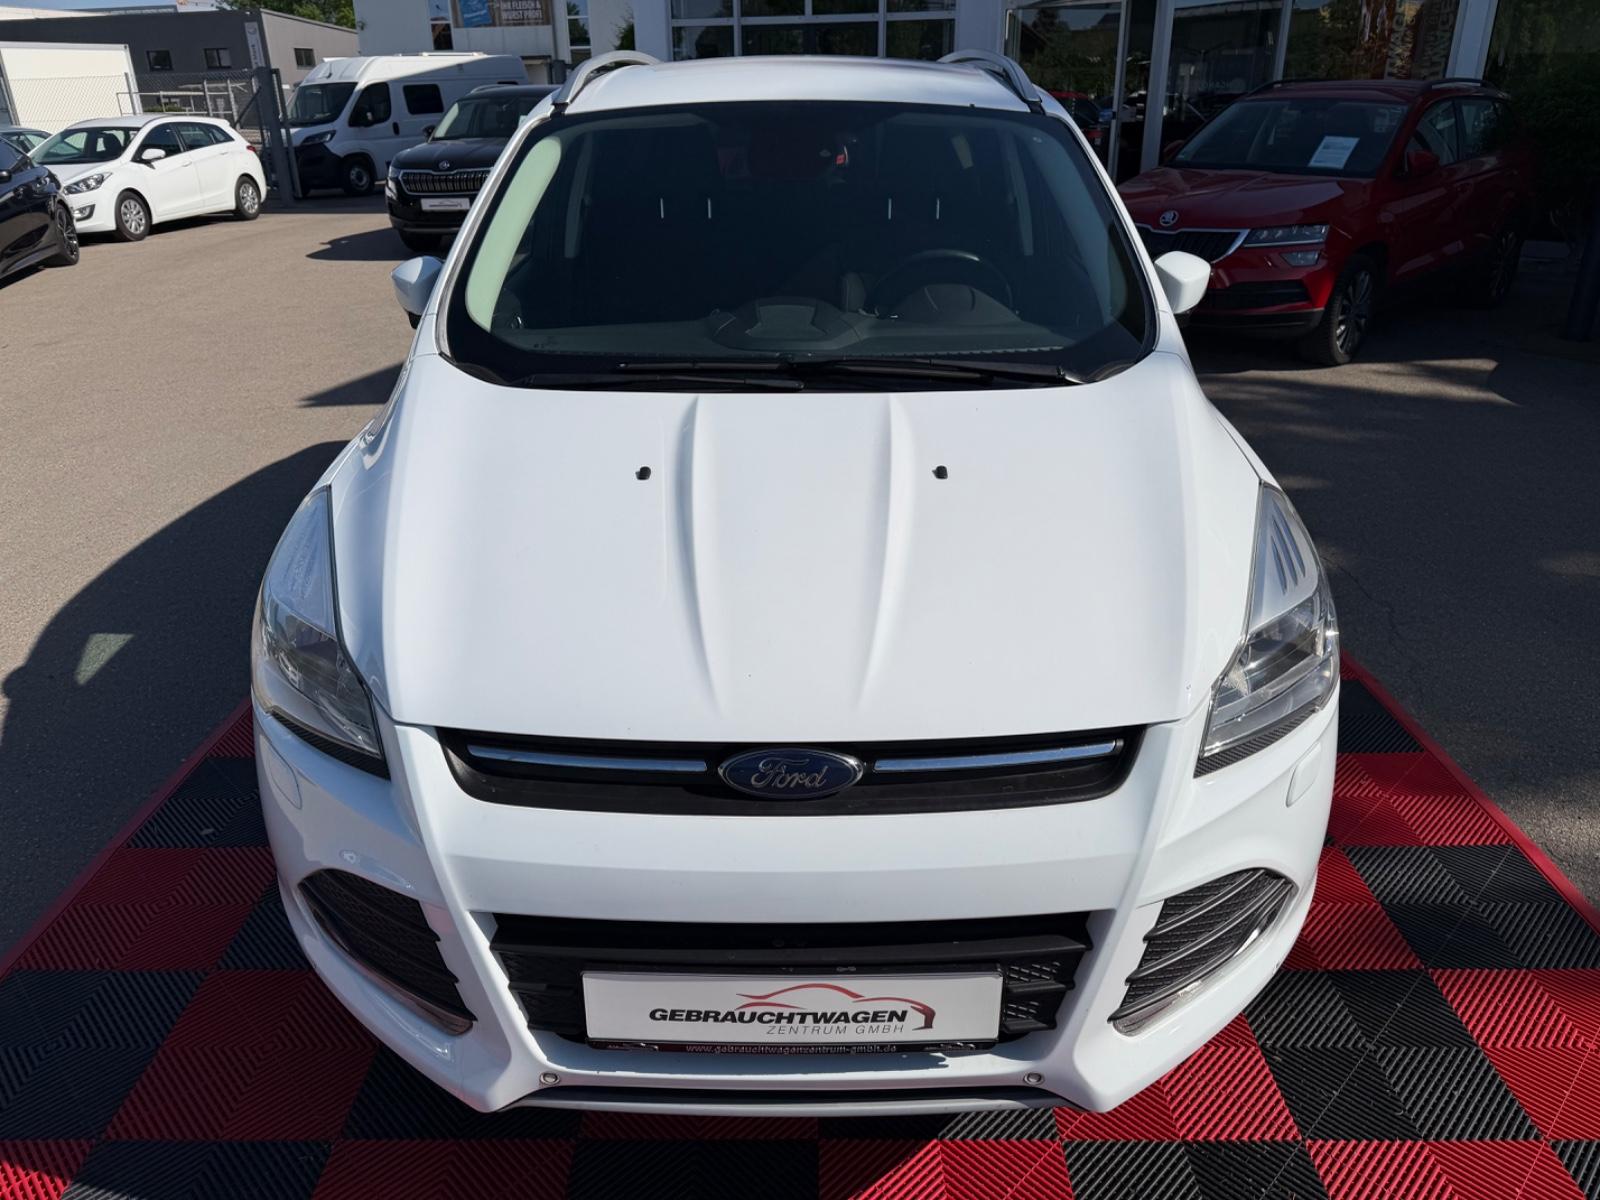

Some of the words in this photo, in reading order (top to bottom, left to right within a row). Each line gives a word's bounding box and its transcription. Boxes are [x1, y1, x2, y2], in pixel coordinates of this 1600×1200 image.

[501, 9, 522, 19] WURST
[522, 8, 542, 19] PROFI
[751, 757, 828, 788] Ford
[649, 1008, 908, 1025] GEBRAUCHTWAGEN
[766, 1025, 847, 1036] ZENTRUM
[855, 1024, 905, 1034] GMBH
[685, 1043, 897, 1056] www.gebrauchtwagenzentrum-gmbh.de
